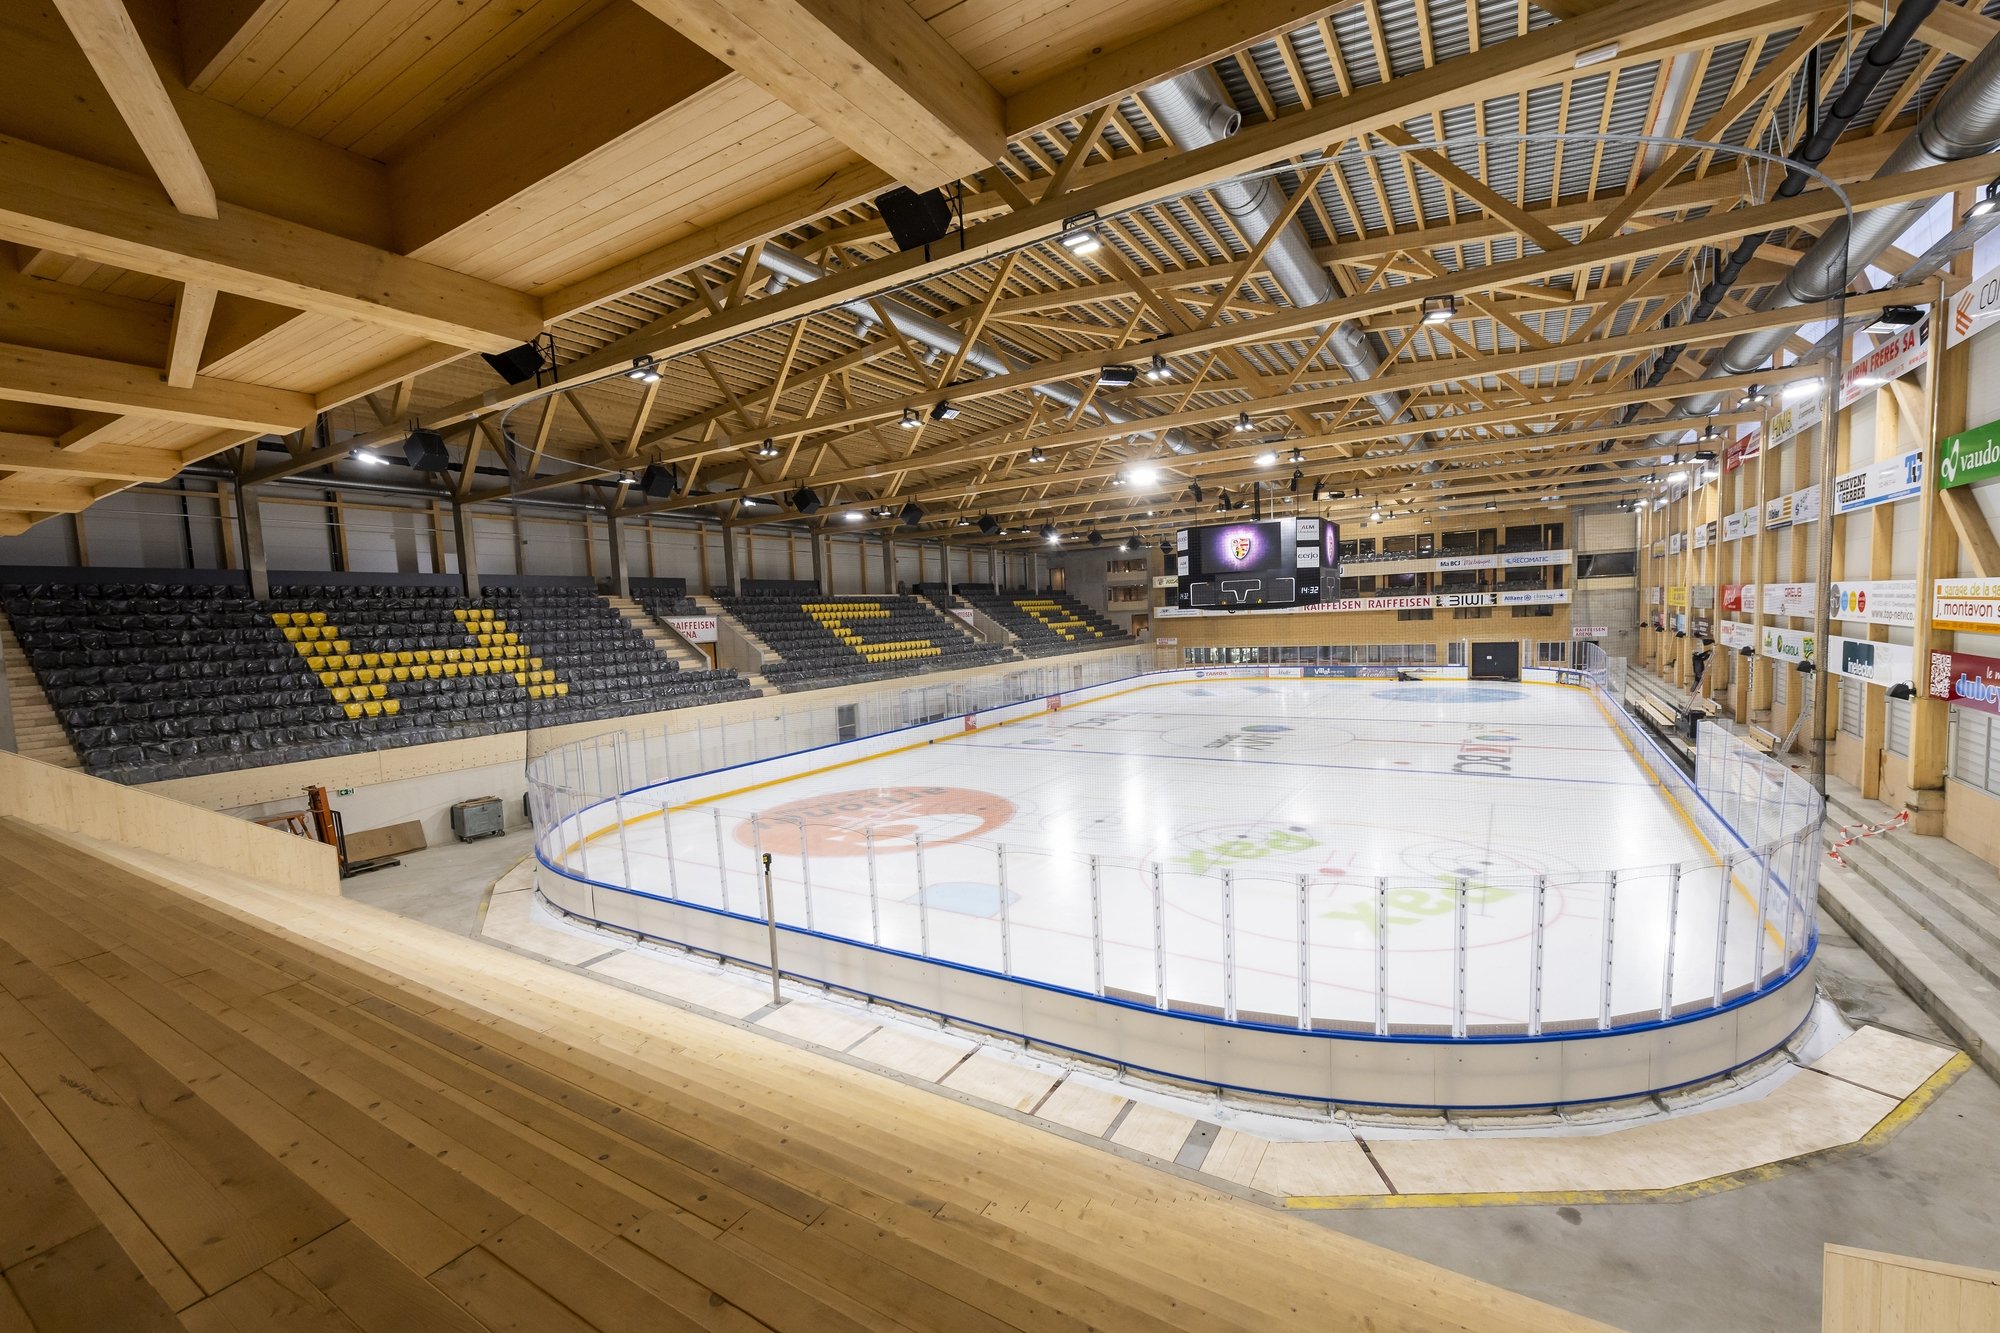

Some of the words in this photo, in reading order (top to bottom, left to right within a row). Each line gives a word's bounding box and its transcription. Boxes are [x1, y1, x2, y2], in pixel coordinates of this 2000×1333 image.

[1902, 329, 1915, 353] SA
[1960, 438, 2000, 472] vaudo
[1512, 556, 1548, 565] RECOMATIC
[1301, 586, 1319, 594] 14:32
[1970, 582, 1981, 596] de
[1983, 582, 1990, 596] la
[1368, 597, 1431, 609] RAIFFEISEN
[1944, 601, 1993, 618] montavon
[1986, 665, 1993, 679] le
